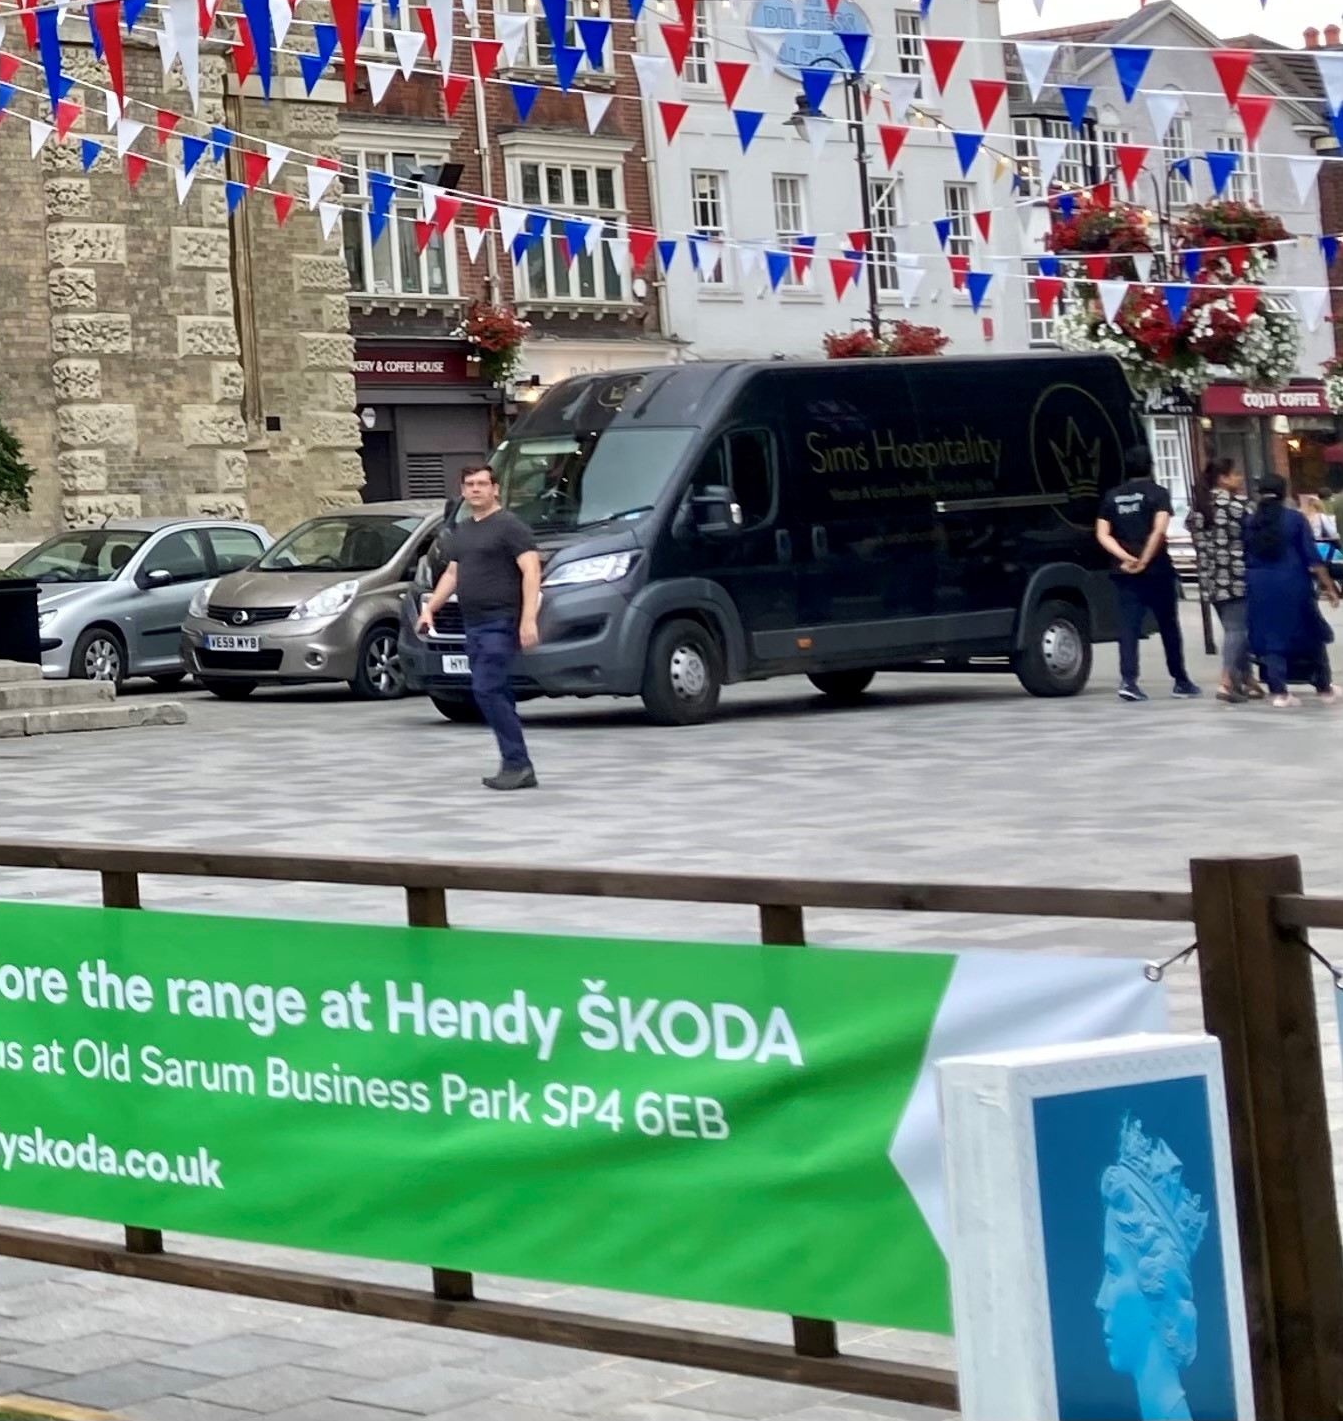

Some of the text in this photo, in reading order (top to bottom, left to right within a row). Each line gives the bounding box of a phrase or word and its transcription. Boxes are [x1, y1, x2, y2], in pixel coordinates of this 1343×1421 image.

[376, 360, 383, 372] &
[384, 360, 415, 372] COFFEE
[416, 361, 444, 372] HOUSE
[1242, 392, 1321, 408] COSTA COFFEE
[872, 425, 1002, 479] Hospitality
[76, 959, 154, 1013] the
[166, 976, 308, 1037] range
[319, 979, 374, 1032] at
[385, 979, 563, 1061] Hendy
[577, 978, 806, 1067] ŠKODA
[31, 1038, 66, 1076] at
[73, 1037, 132, 1082] Old
[140, 1045, 256, 1097] Sarum
[265, 1055, 431, 1114] Business
[440, 1073, 533, 1124] Park
[542, 1081, 625, 1132] SP4
[634, 1091, 731, 1140] 6EB
